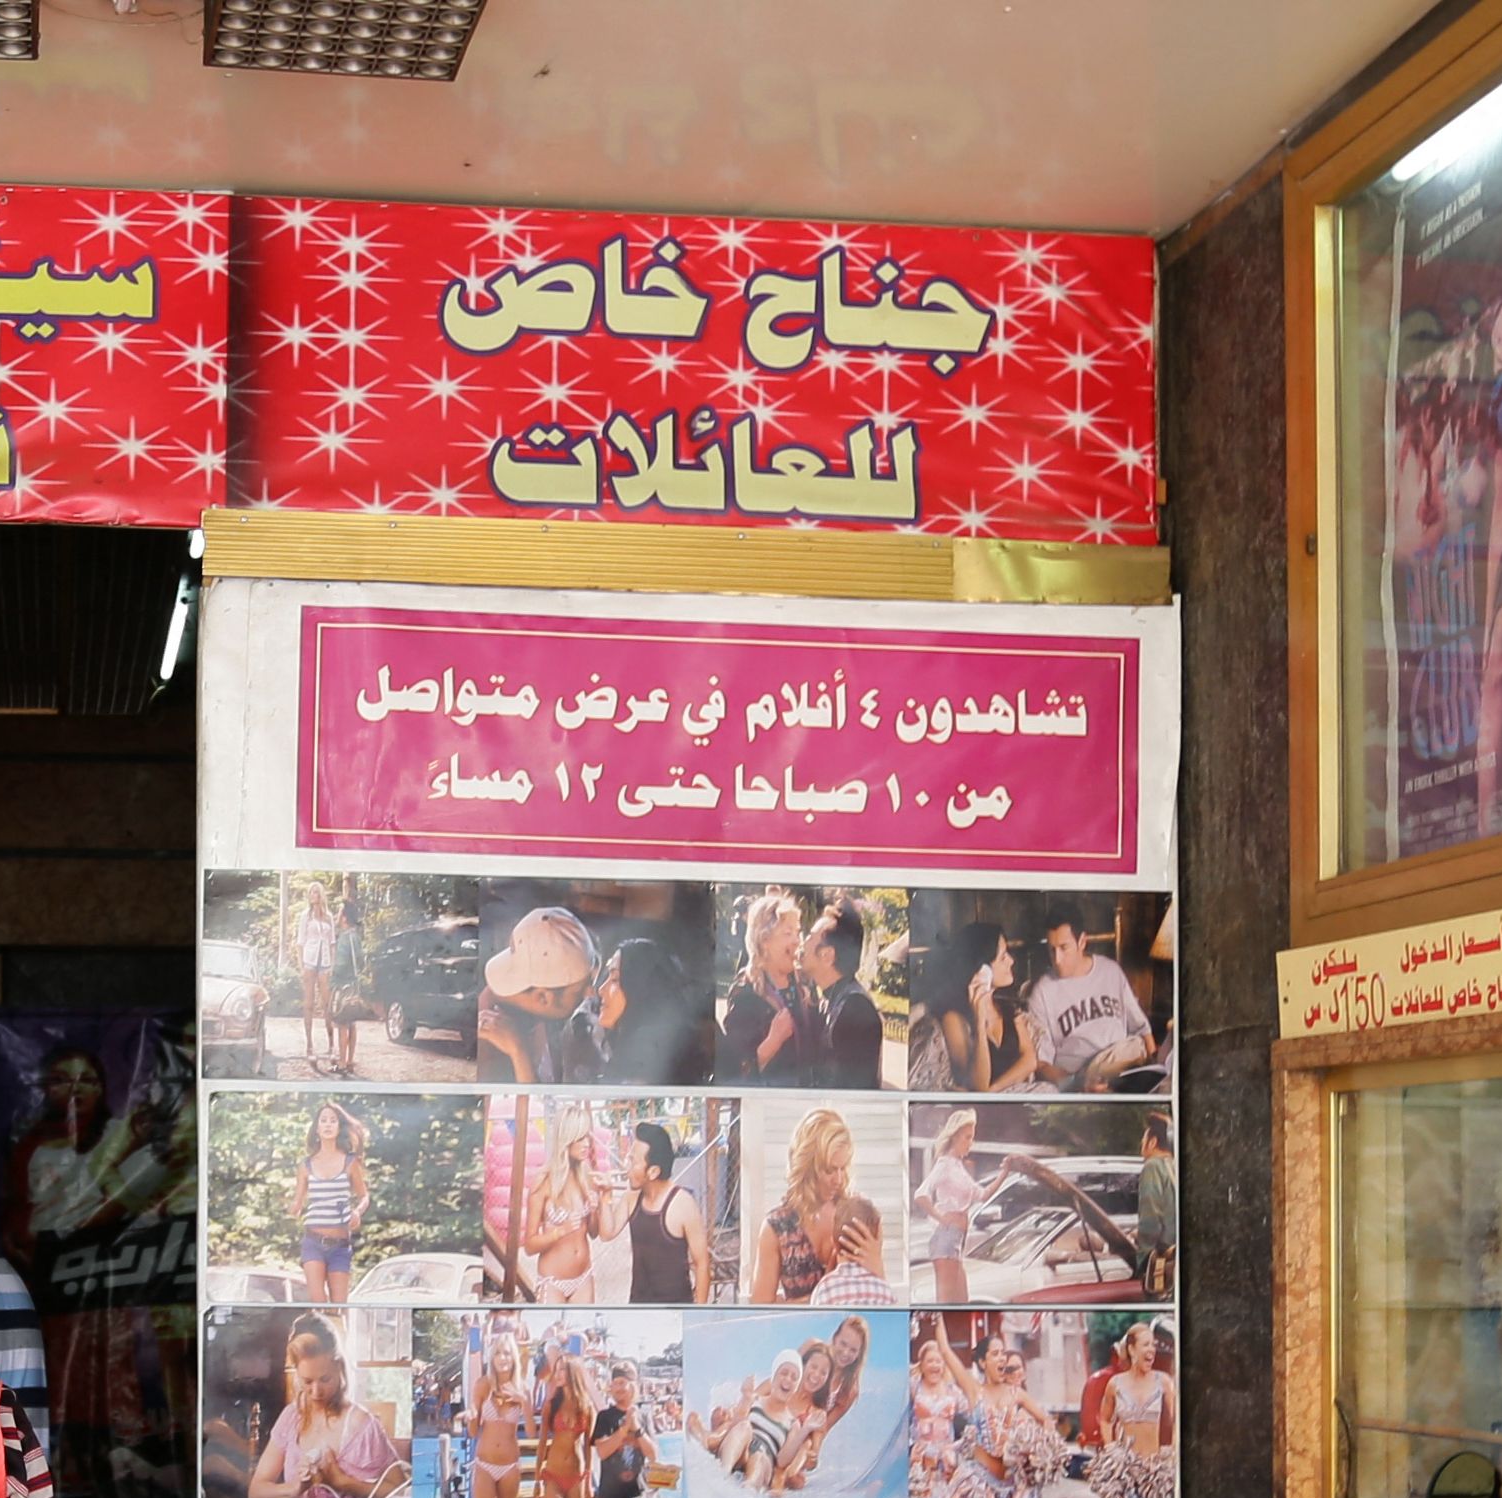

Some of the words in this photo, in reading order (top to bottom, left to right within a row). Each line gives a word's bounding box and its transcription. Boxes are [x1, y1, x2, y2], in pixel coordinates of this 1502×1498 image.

[440, 233, 712, 353] خاص
[744, 246, 995, 377] جناح
[490, 407, 919, 521] للعائلات
[355, 664, 541, 725] متواصل
[556, 672, 669, 732] عرض
[681, 674, 726, 746] في
[746, 669, 847, 743] أفلام
[861, 701, 881, 729] ٤
[894, 684, 1089, 744] تشاهدون
[617, 770, 721, 817] حتى
[734, 764, 867, 825] صباحا
[945, 783, 1013, 831] من
[1400, 934, 1453, 974] الدخول
[1340, 972, 1385, 1032] 150
[1391, 985, 1443, 1017] للعائلات
[1447, 977, 1482, 1015] خاص
